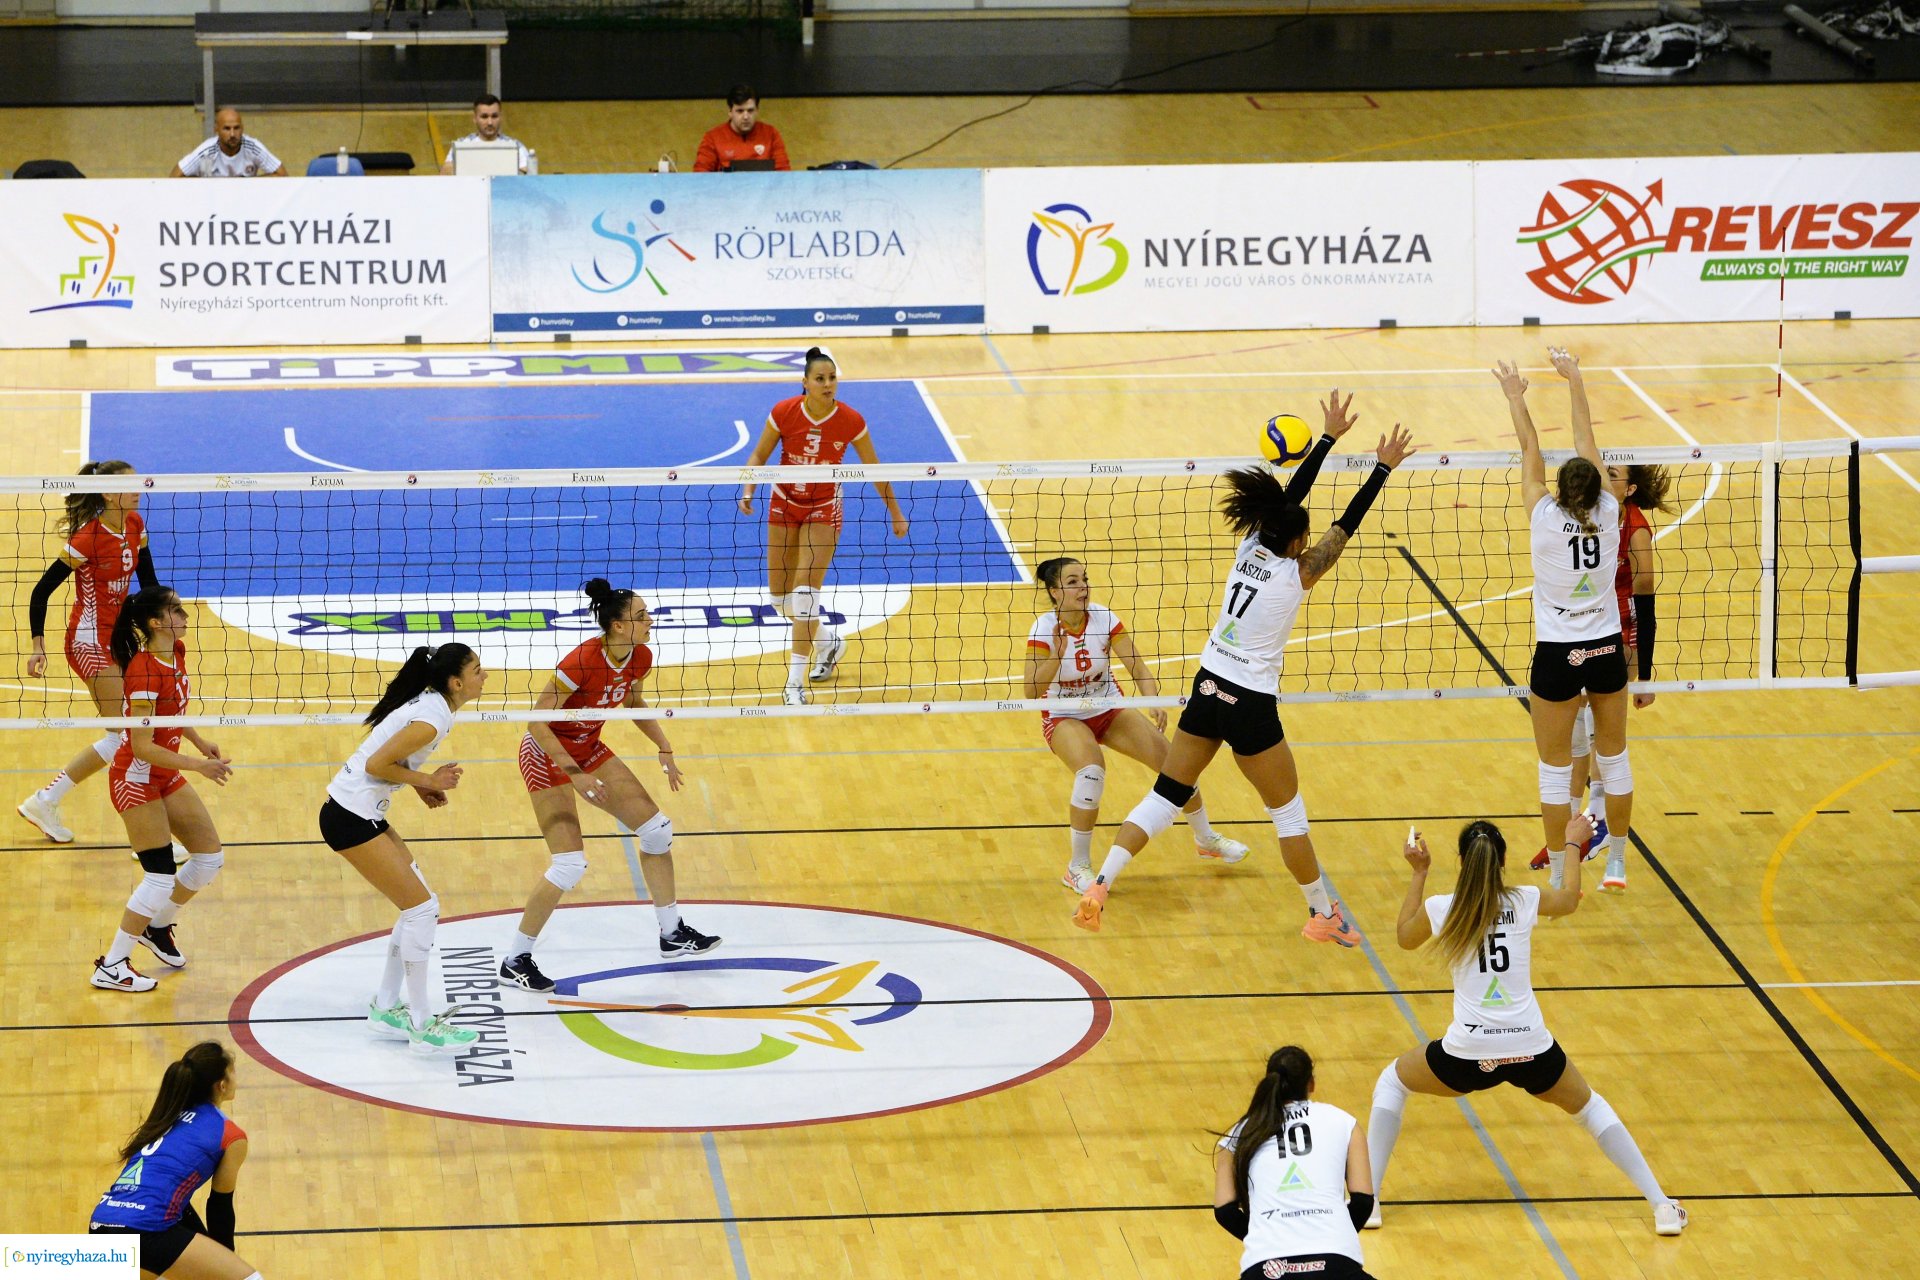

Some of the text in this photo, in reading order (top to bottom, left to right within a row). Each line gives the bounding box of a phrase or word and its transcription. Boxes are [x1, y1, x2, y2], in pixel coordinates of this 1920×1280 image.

[776, 210, 842, 224] MAGYAR
[159, 212, 392, 247] NYÍREGYHÁZI
[1664, 201, 1920, 253] REVESZ
[715, 226, 905, 260] RÖPLABDA
[1145, 226, 1433, 268] NYÍREGYHÁZA
[159, 258, 447, 288] SPORTCENTRUM
[767, 265, 853, 281] SZÖVETSÉG
[1707, 262, 1766, 276] ALWAYS
[1794, 261, 1820, 274] THE
[1824, 260, 1869, 273] RIGHT
[1872, 259, 1904, 272] WAY
[1145, 270, 1433, 289] MEGYEI JOGÚ VÁROS ÖNKORMÁNYZATA
[160, 294, 448, 313] Nyíregyházi Sportcentrum Nonprofit Kft.
[803, 433, 821, 456] 3
[1601, 451, 1634, 462] FATUM
[832, 468, 865, 479] FATUM
[1090, 463, 1123, 474] FATUM
[42, 479, 76, 490] FATUM
[311, 475, 344, 487] FATUM
[572, 472, 605, 483] FATUM
[122, 548, 133, 571] 9
[1567, 535, 1601, 570] 19
[1227, 581, 1259, 619] 17
[1074, 649, 1092, 672] 6
[597, 681, 628, 706] 16
[740, 707, 767, 717] FATUM
[997, 701, 1023, 710] FATUM
[219, 716, 246, 726] FATUM
[481, 712, 508, 721] FATUM
[1478, 932, 1510, 974] 15
[1483, 1025, 1531, 1036] BESTRONG
[1275, 1122, 1313, 1160] 10
[1281, 1207, 1334, 1219] BESTRONG
[1286, 1261, 1326, 1272] REVESZ
